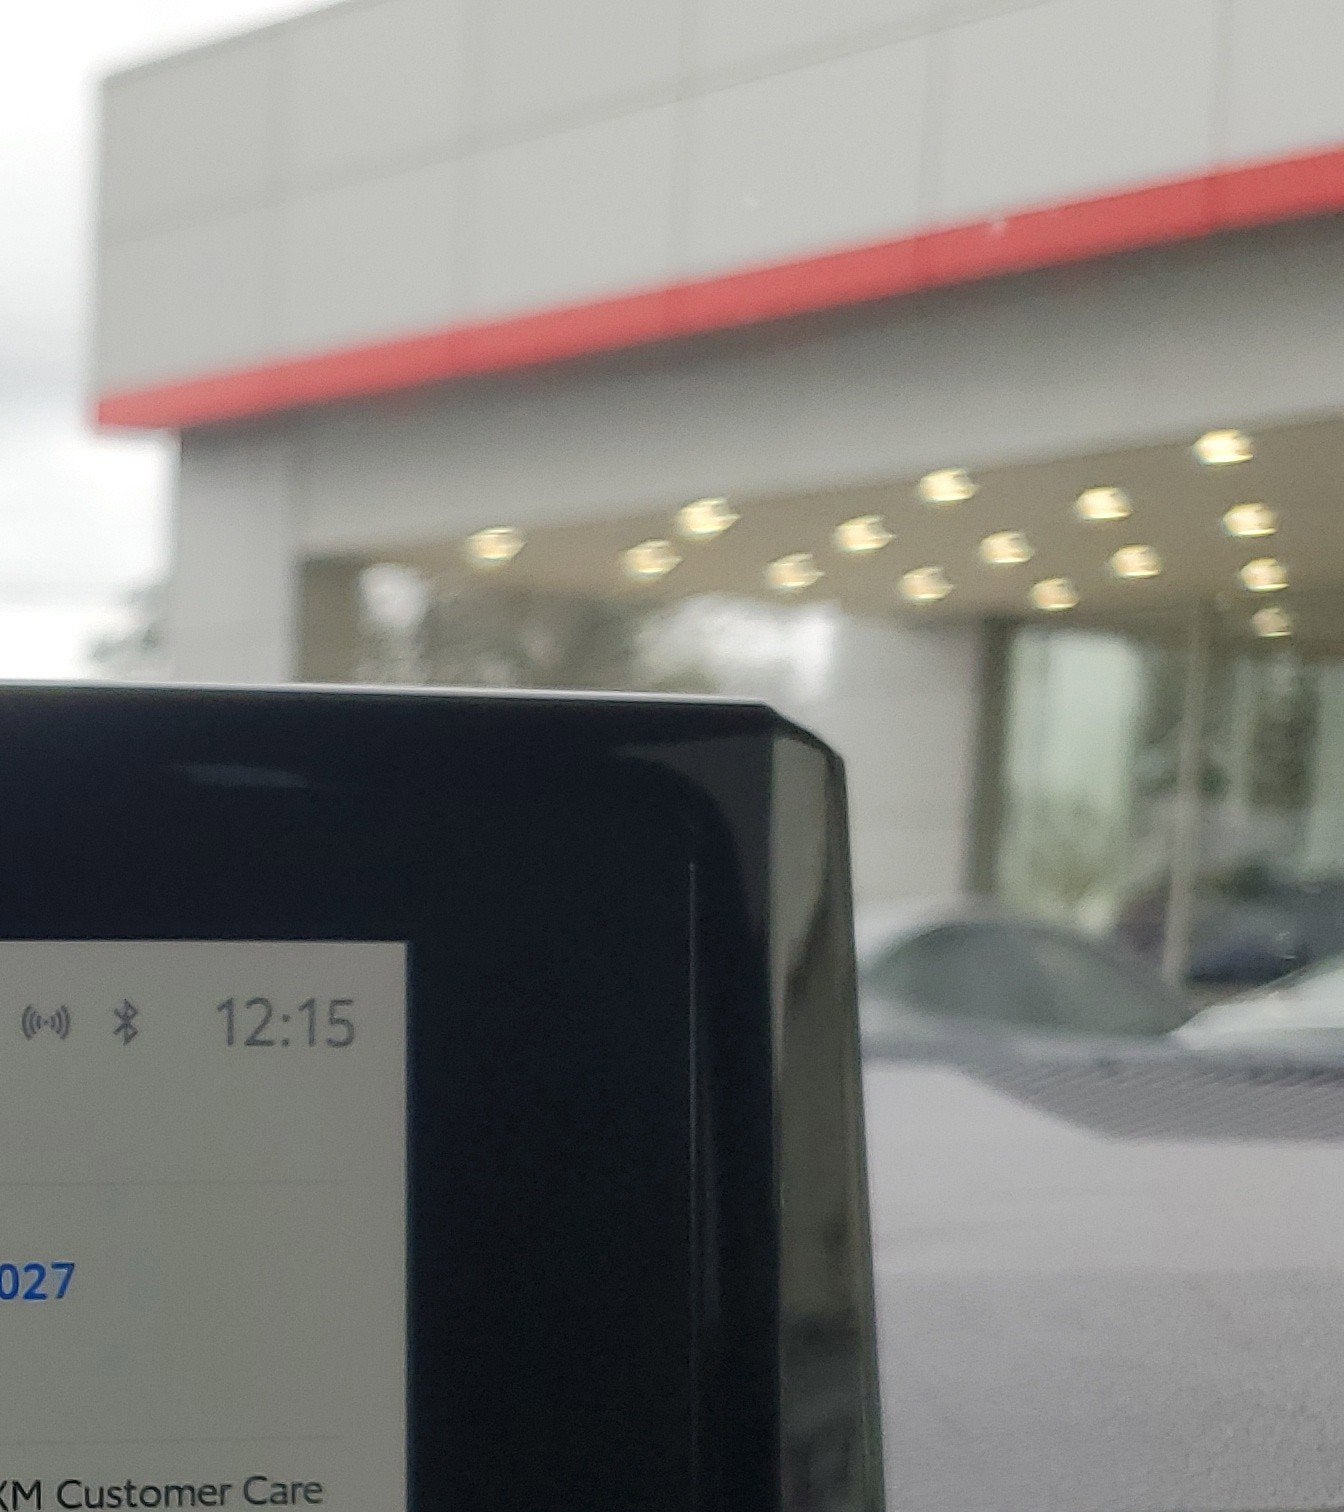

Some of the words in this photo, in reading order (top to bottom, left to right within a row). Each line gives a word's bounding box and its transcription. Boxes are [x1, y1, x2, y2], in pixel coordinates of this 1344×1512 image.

[217, 996, 355, 1048] 12:15
[57, 1479, 233, 1510] Customer
[243, 1475, 323, 1505] Care
